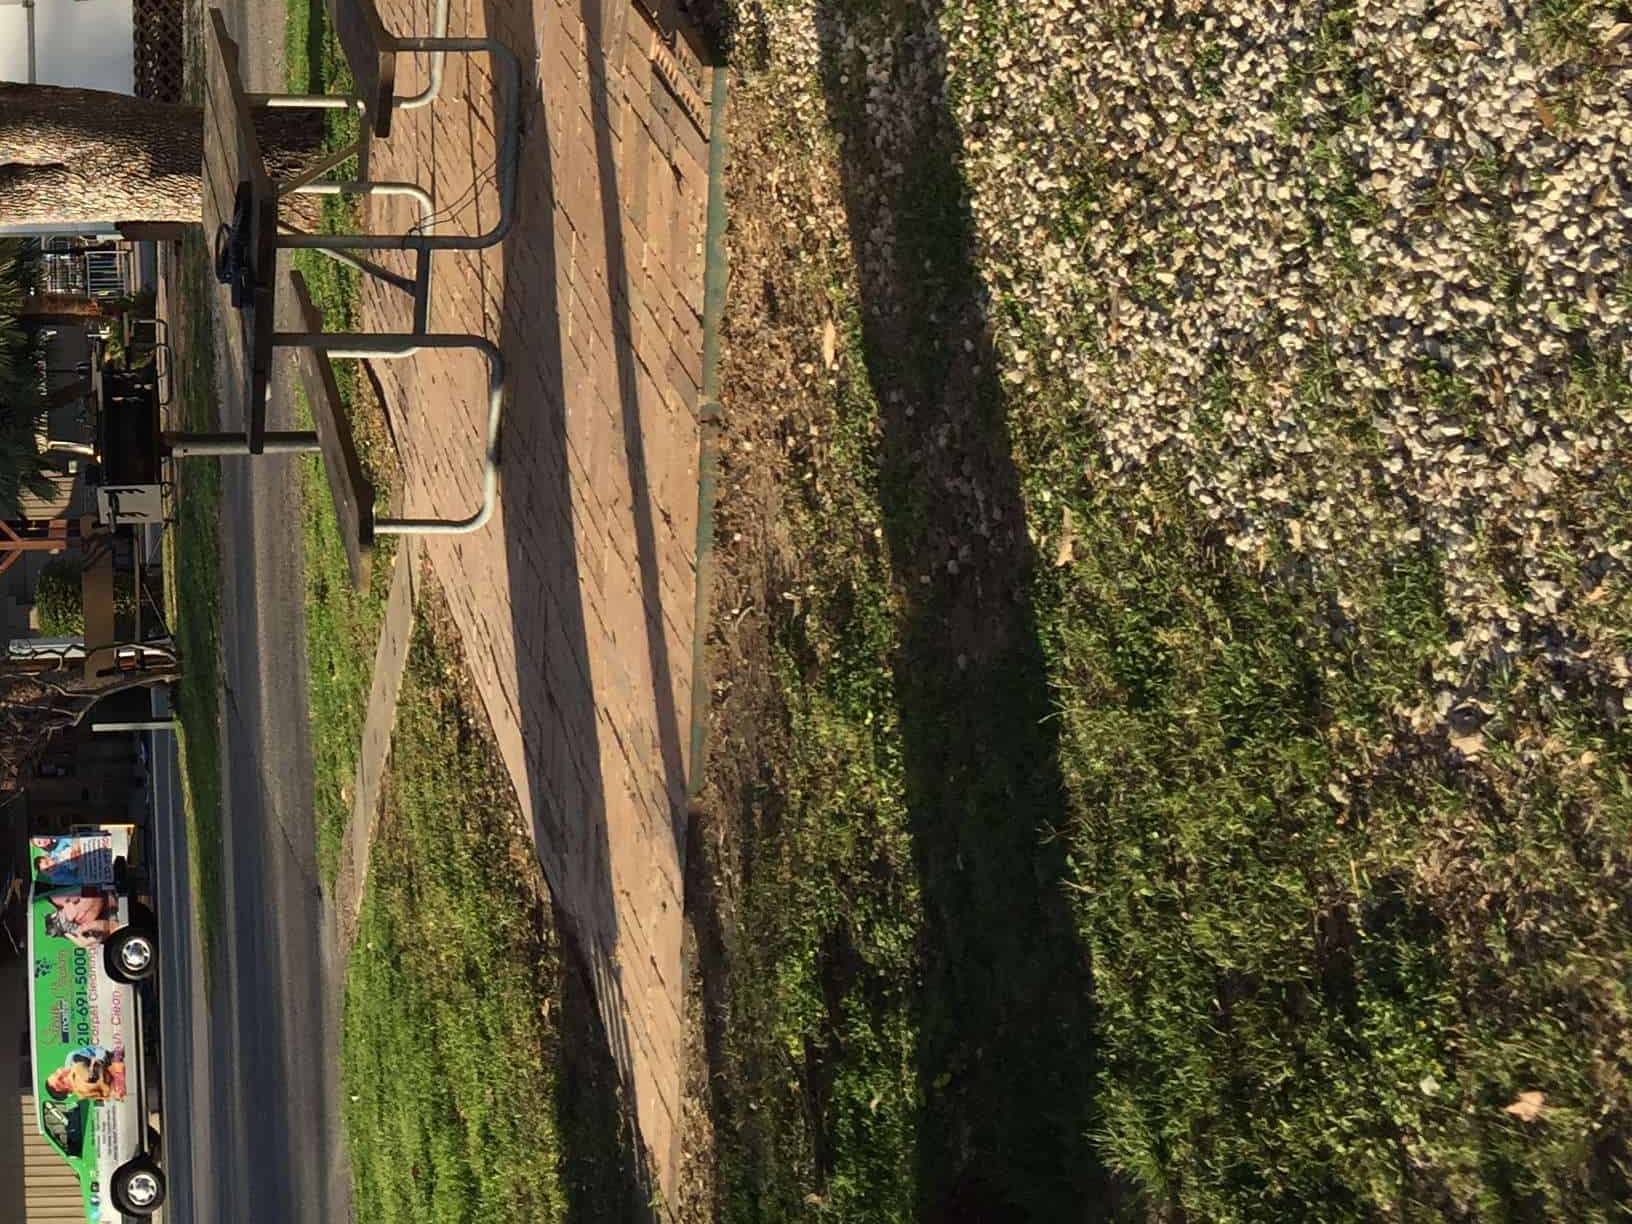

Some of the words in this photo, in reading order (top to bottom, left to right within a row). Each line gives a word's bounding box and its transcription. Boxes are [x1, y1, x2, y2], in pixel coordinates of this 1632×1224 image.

[74, 947, 89, 1046] 210-691-5000
[88, 946, 98, 1000] Cleaning
[89, 1005, 99, 1045] Carpet
[110, 990, 121, 1025] Clean
